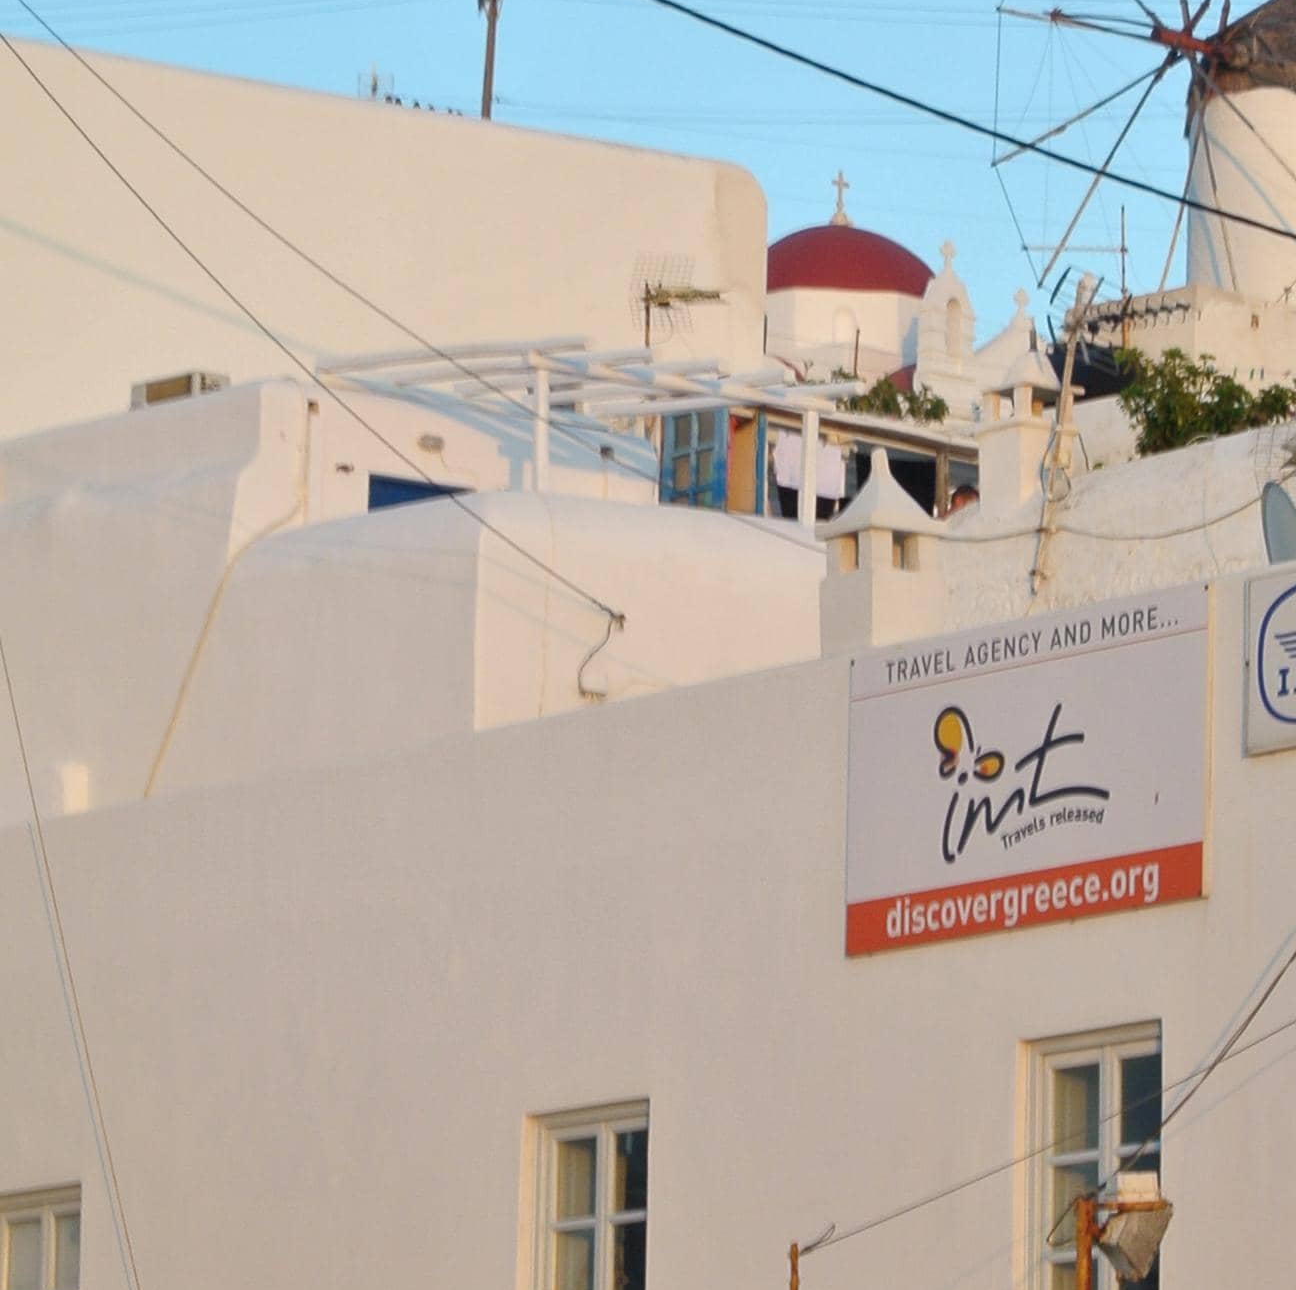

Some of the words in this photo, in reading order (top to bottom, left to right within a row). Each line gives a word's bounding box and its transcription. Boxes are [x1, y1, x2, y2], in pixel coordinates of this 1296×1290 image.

[886, 650, 955, 684] TRAVEL
[964, 631, 1041, 669] AGENCY
[1050, 620, 1091, 650] AND
[1101, 607, 1179, 640] MORE...
[942, 703, 1110, 864] imt
[1001, 816, 1046, 850] Travels
[1050, 808, 1105, 825] released
[886, 862, 1160, 939] discovergreece.org
